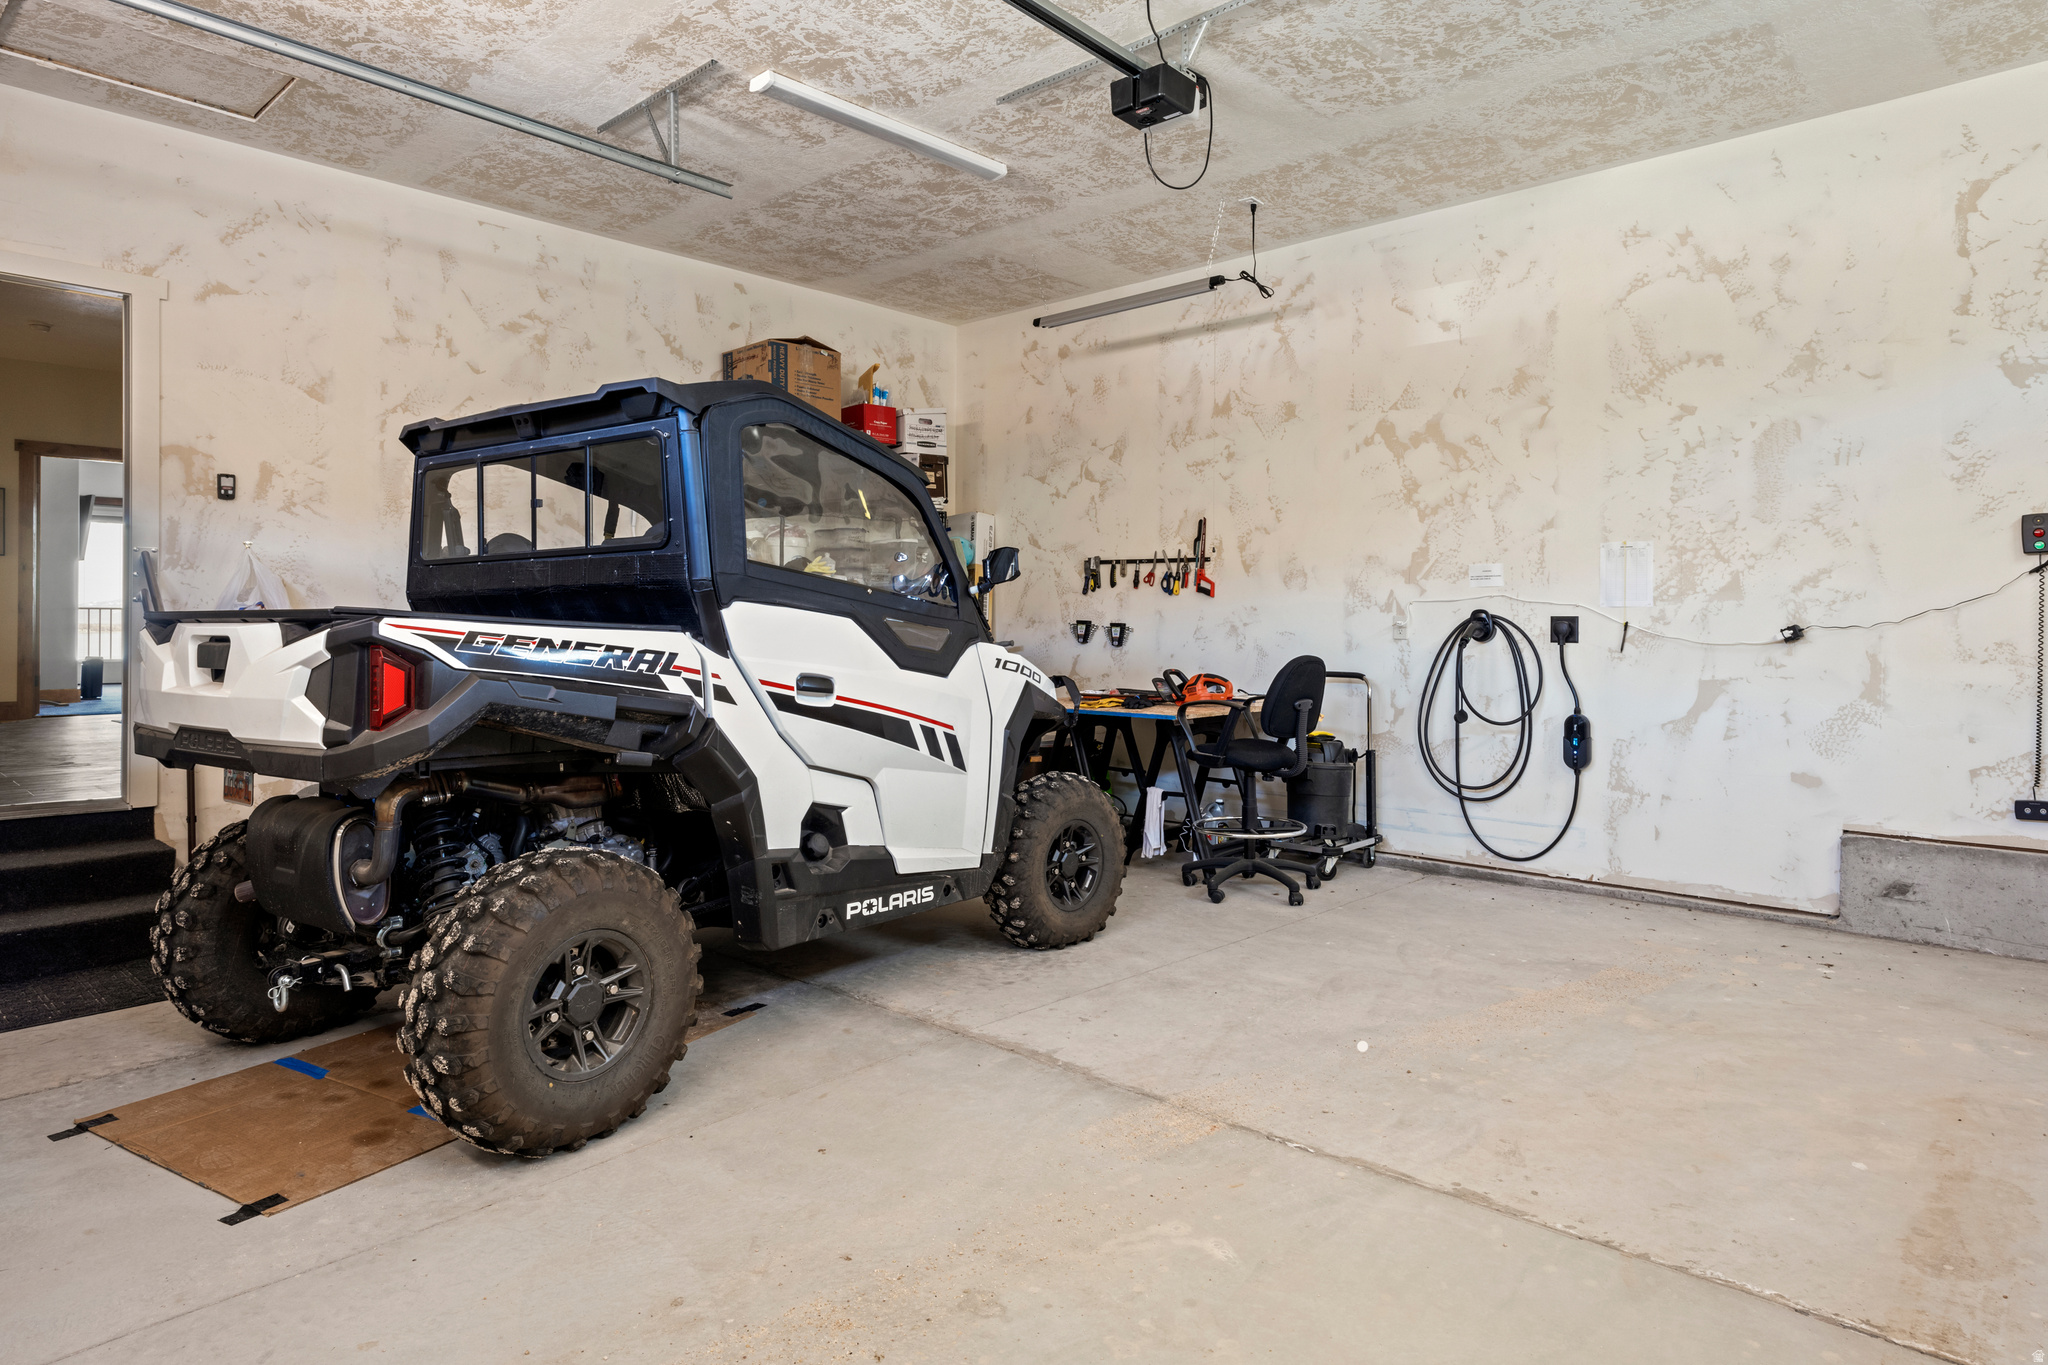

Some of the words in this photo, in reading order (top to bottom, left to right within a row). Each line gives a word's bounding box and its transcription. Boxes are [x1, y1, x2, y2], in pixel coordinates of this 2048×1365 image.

[454, 630, 684, 677] GENERAL
[995, 657, 1042, 684] 1000
[180, 731, 237, 754] POLARIS
[846, 885, 935, 920] POLARIS
